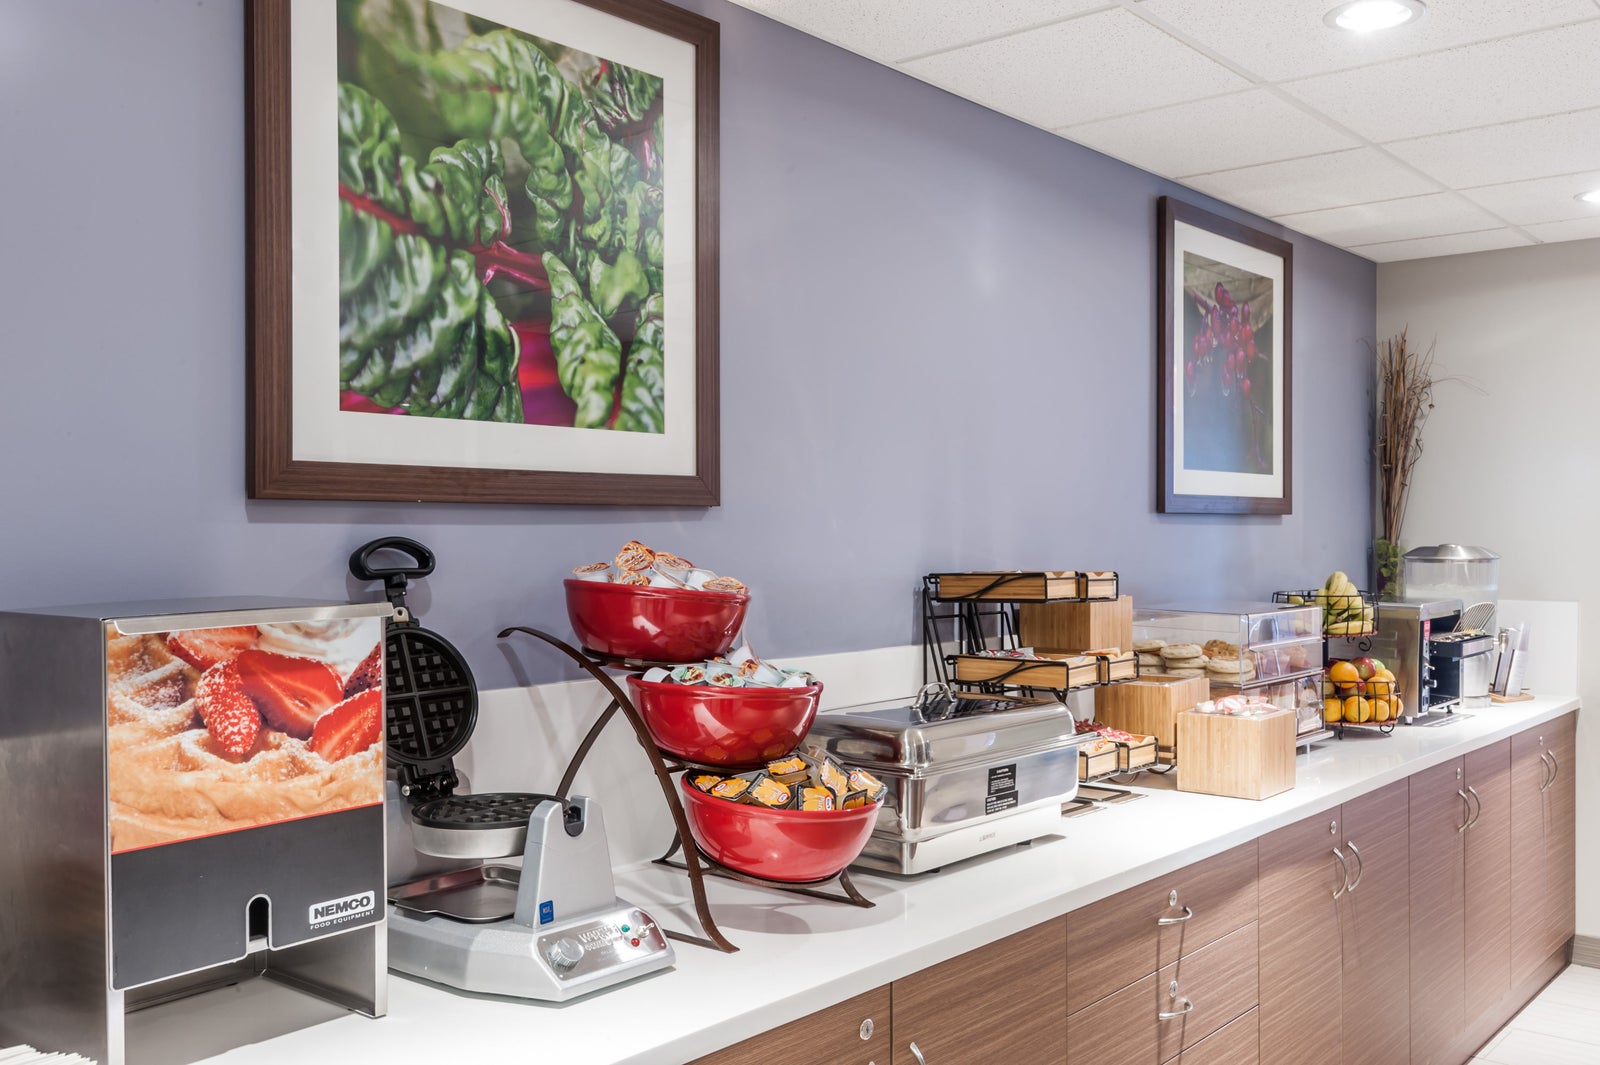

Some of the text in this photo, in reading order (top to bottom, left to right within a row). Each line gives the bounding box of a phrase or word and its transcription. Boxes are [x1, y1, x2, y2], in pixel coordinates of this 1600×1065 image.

[314, 896, 371, 919] NEMCO
[310, 910, 375, 930] FOOD EQUIPMENT
